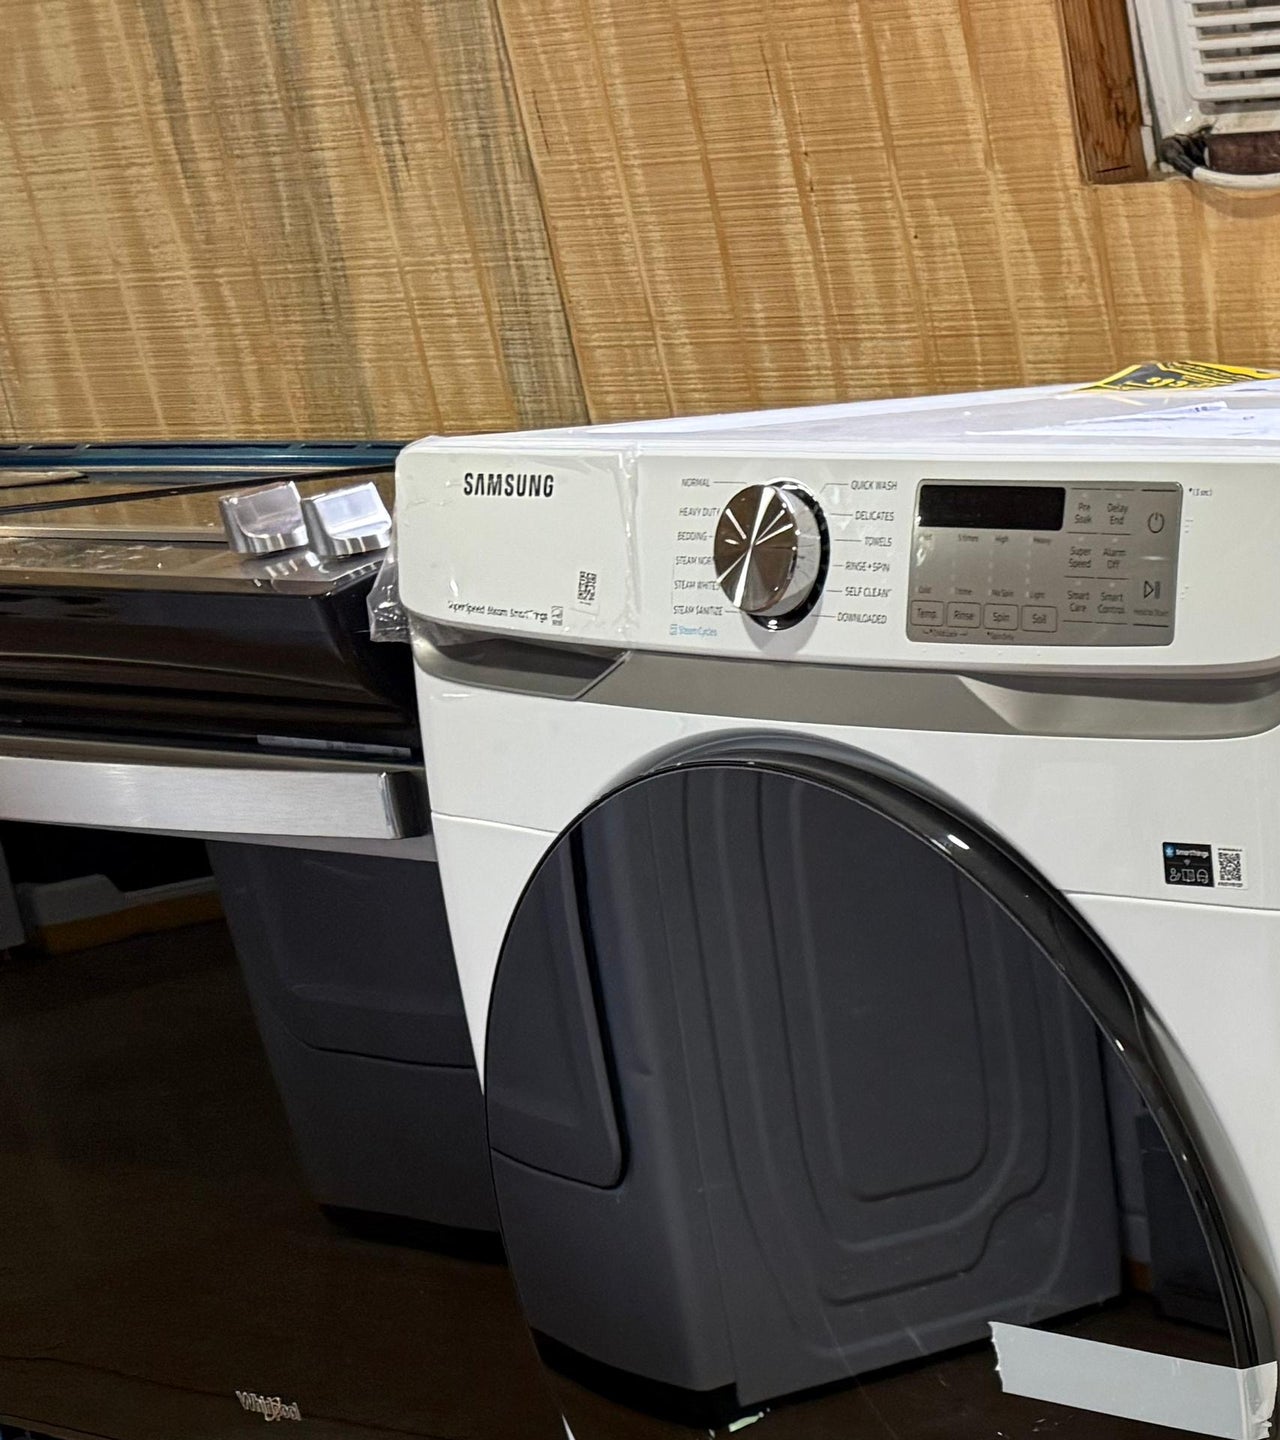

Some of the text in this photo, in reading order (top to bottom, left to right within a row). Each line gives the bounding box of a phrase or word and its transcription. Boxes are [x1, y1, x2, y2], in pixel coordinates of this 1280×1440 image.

[464, 472, 554, 497] SAMSUNG
[681, 478, 710, 487] NORMAL
[851, 480, 898, 491] QUICK WASH
[679, 507, 701, 516] HEAVY
[855, 511, 894, 521] DELICATES
[677, 531, 707, 541] BEDDING
[864, 536, 893, 547] TOWELS
[845, 586, 862, 597] SELF
[837, 611, 888, 624] DOWNLOADED
[993, 611, 1010, 622] Spin
